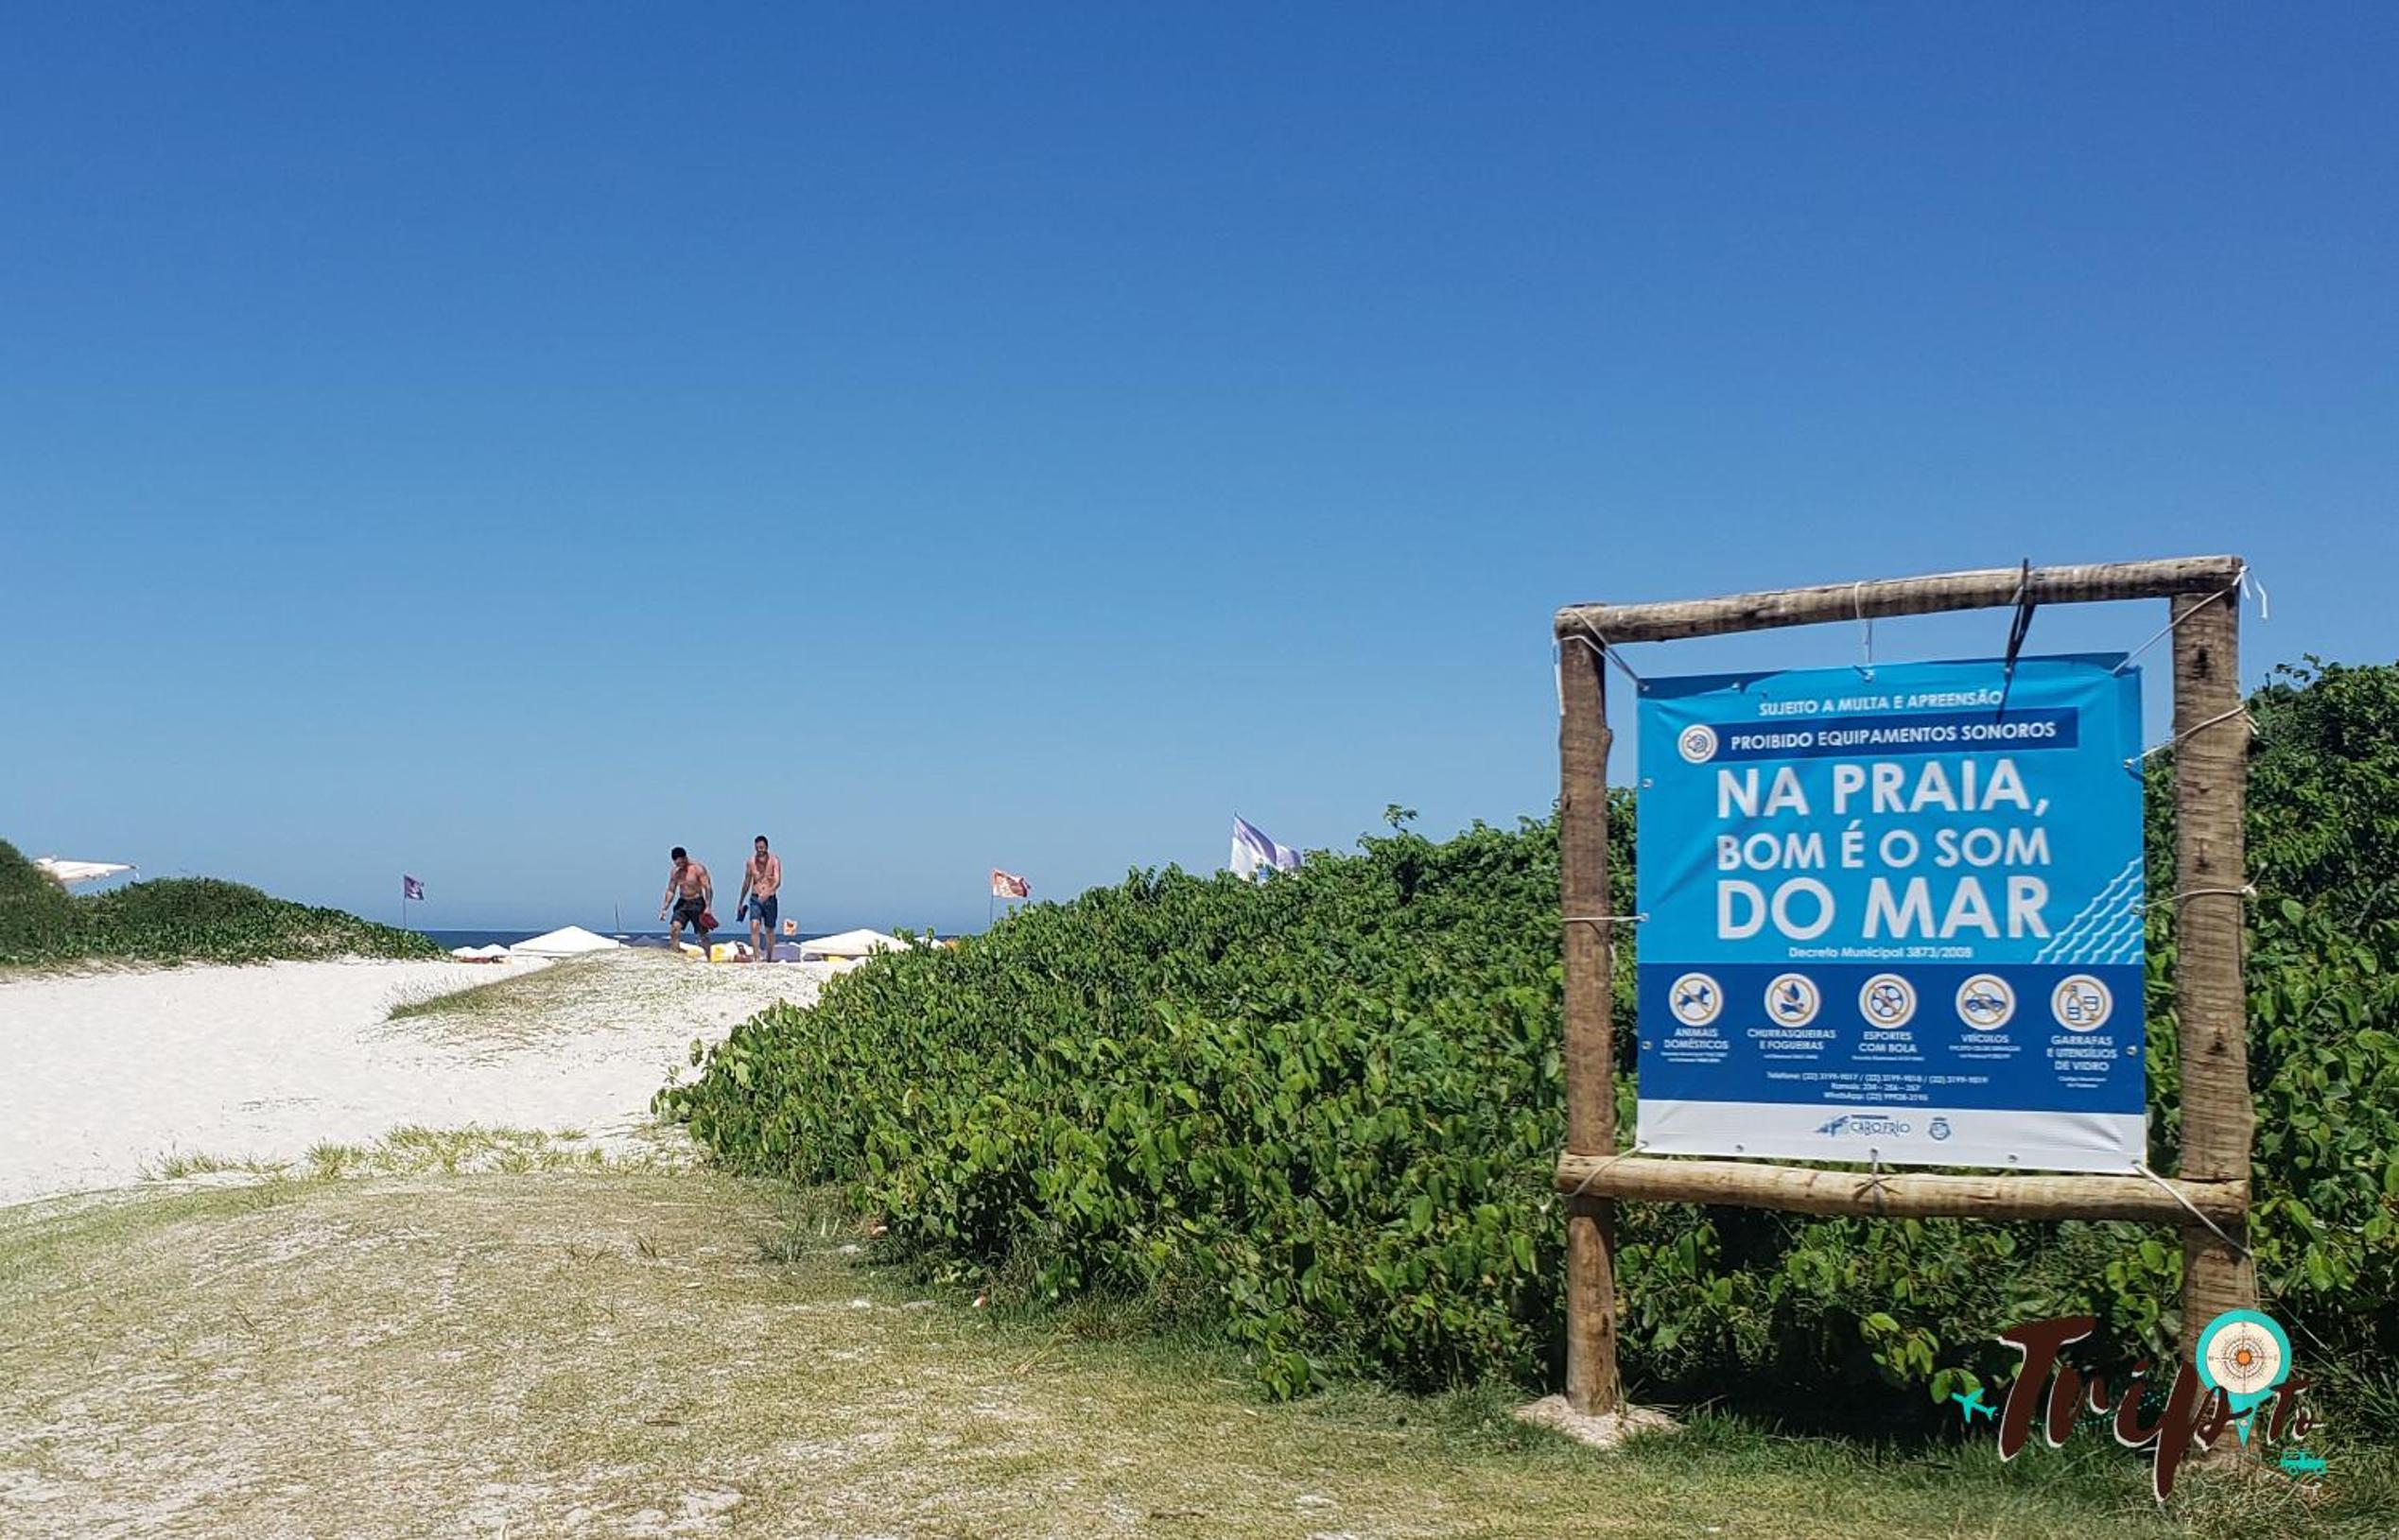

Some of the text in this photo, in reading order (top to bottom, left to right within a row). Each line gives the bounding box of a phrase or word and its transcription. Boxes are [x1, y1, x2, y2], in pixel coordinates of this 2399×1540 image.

[1759, 688, 2003, 717] SUJEITO A MULTA E APREENSÃO
[1730, 721, 2057, 751] PROIBIDO EQUIPAMENTOS SONOROS
[1717, 758, 2050, 819] NA PRAIA,
[1717, 819, 2051, 871] BOM É O SOM
[1717, 875, 2052, 941] DO MAR
[1788, 946, 1837, 959] Decreto
[1840, 946, 1904, 960] Municipal
[1674, 1028, 1719, 1038] ANIMAIS
[1747, 1029, 1836, 1039] CHURRASQUEIRAS
[1863, 1030, 1912, 1041] ESPORTES
[1960, 1032, 2009, 1044] VEÍCULOS
[1663, 1038, 1730, 1050] DOMÉSTICOS
[1767, 1041, 1825, 1050] FOGUEIRAS
[2050, 1034, 2113, 1046] GARRAFAS
[1858, 1043, 1918, 1053] COM BOLA
[2054, 1060, 2111, 1072] DE VIDRO
